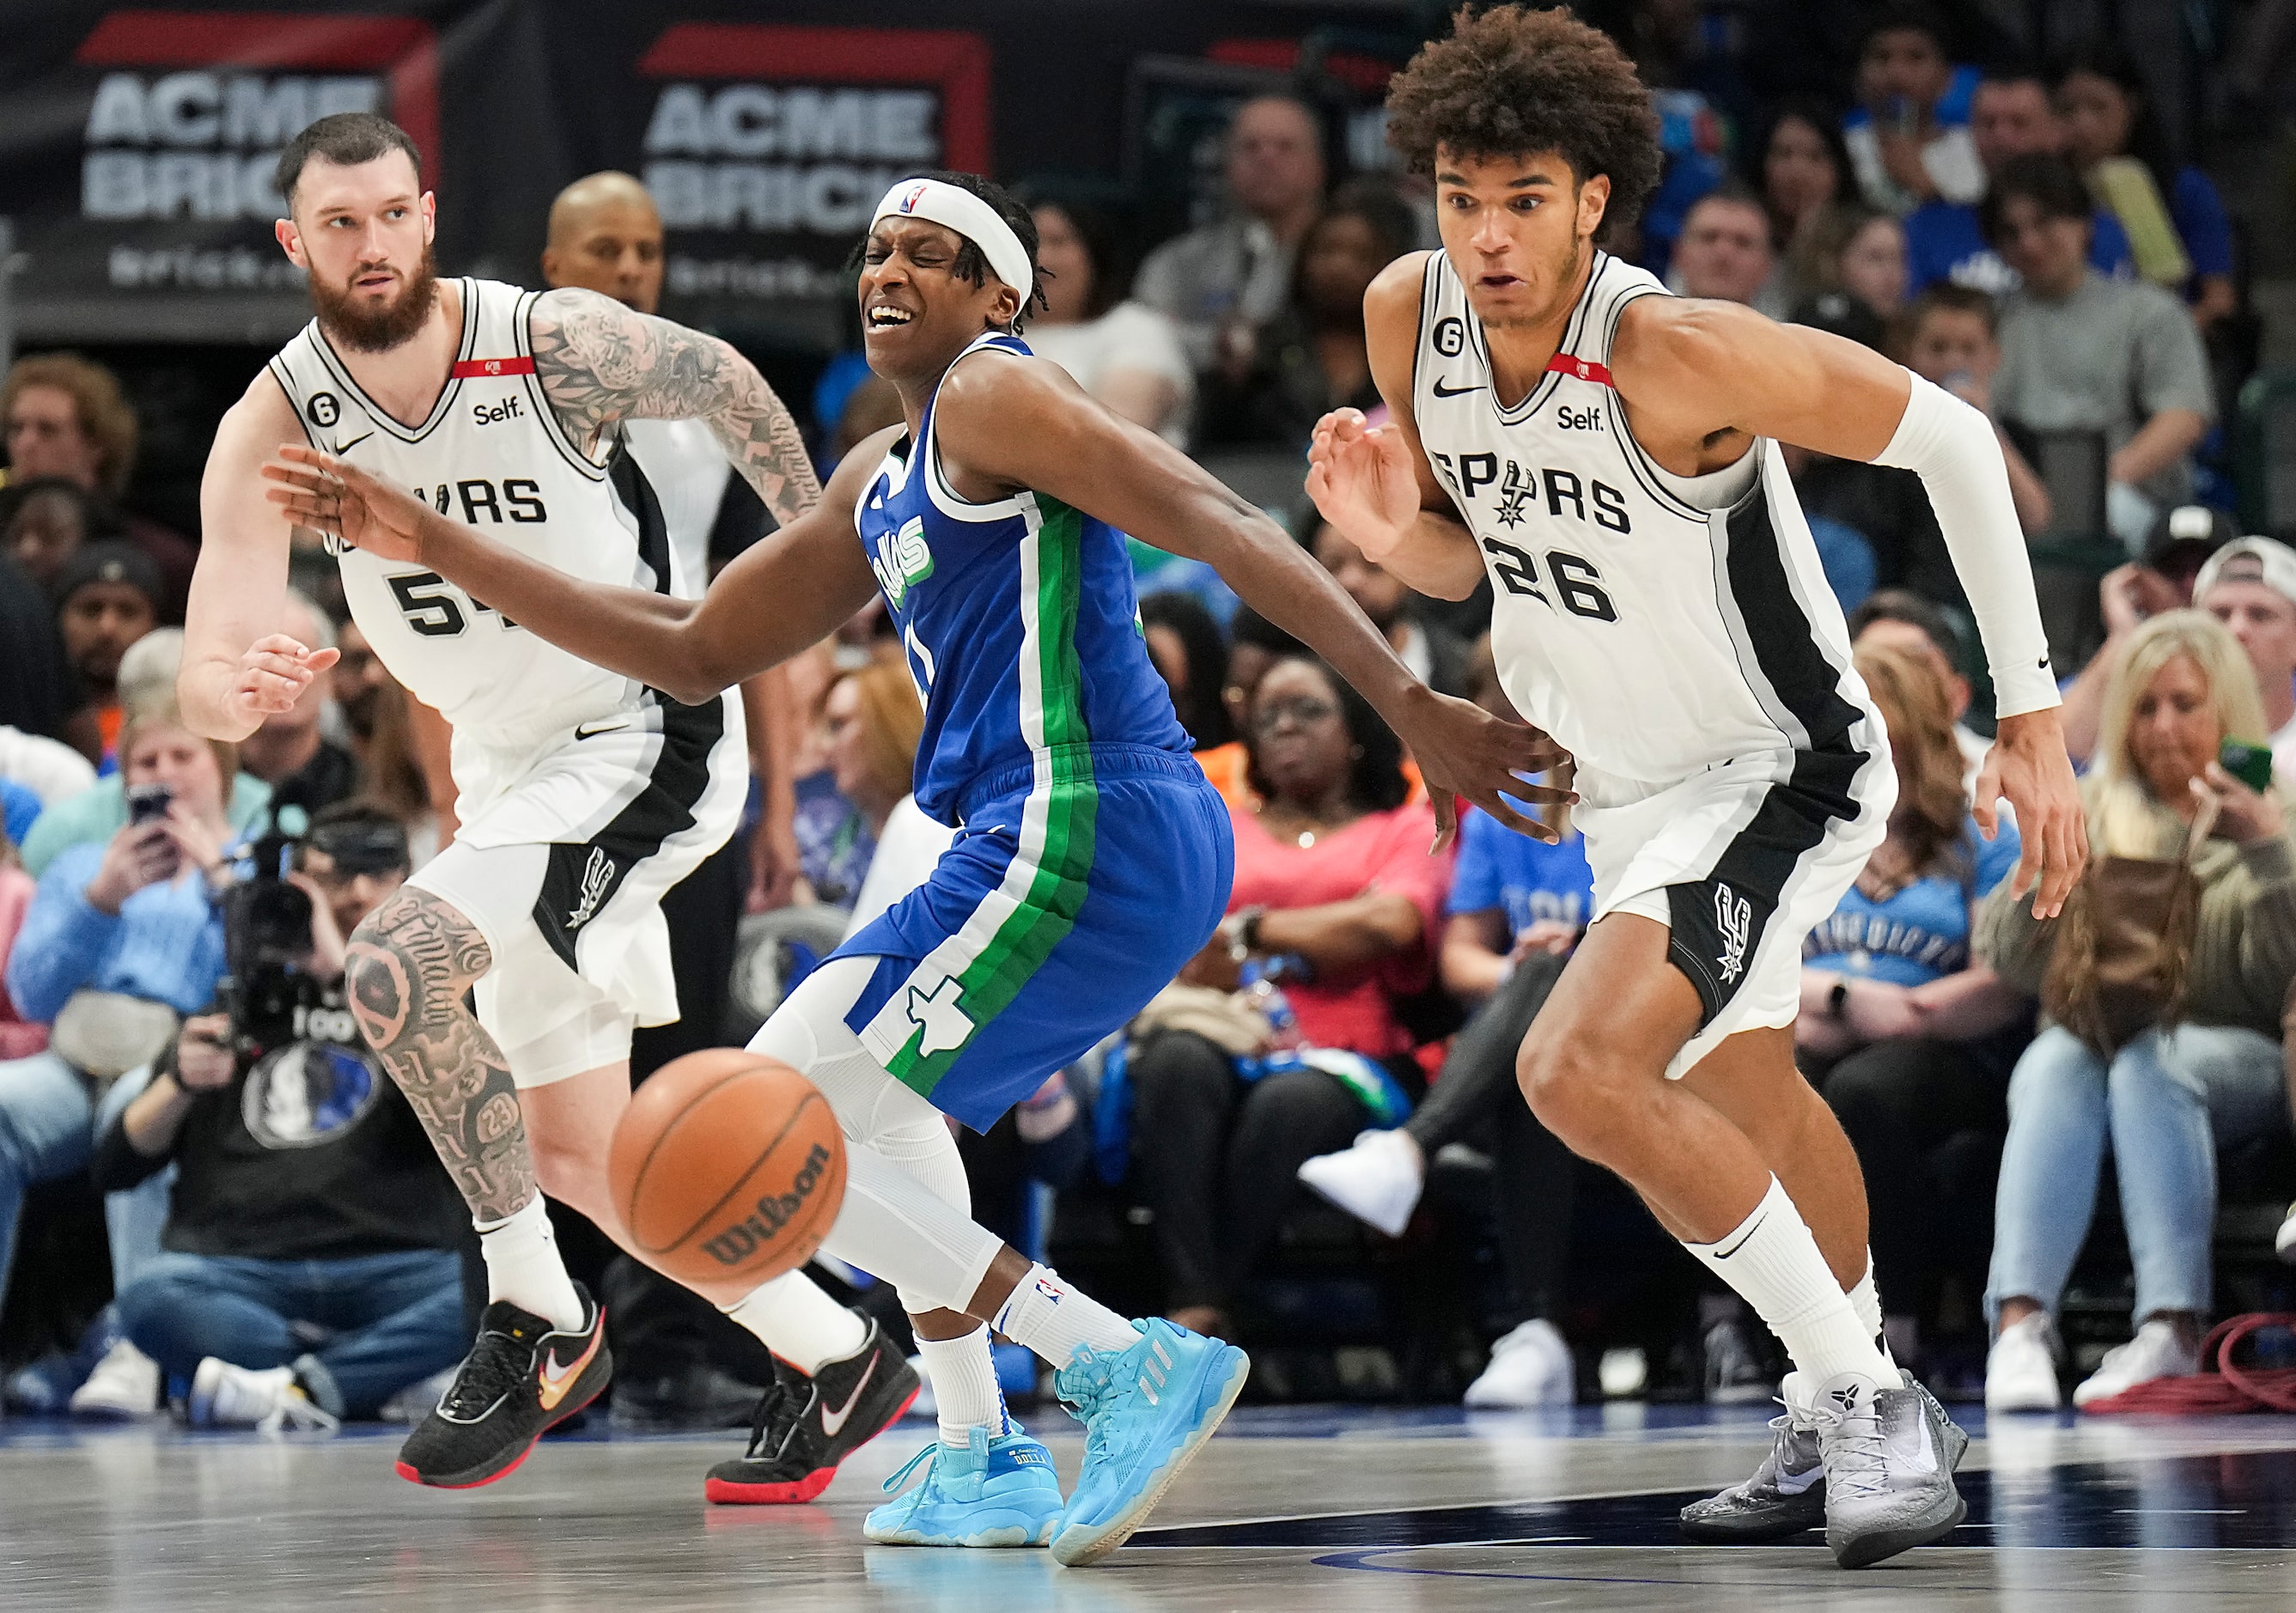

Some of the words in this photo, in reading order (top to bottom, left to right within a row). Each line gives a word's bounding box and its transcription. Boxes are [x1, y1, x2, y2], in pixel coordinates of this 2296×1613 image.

[644, 84, 938, 161] ACME
[82, 149, 289, 221] BRIC
[1440, 320, 1462, 356] 6
[317, 394, 338, 423] 6
[472, 395, 525, 425] Self.
[1556, 405, 1605, 432] Self.
[1479, 533, 1621, 625] 26
[702, 1142, 831, 1265] Wilson
